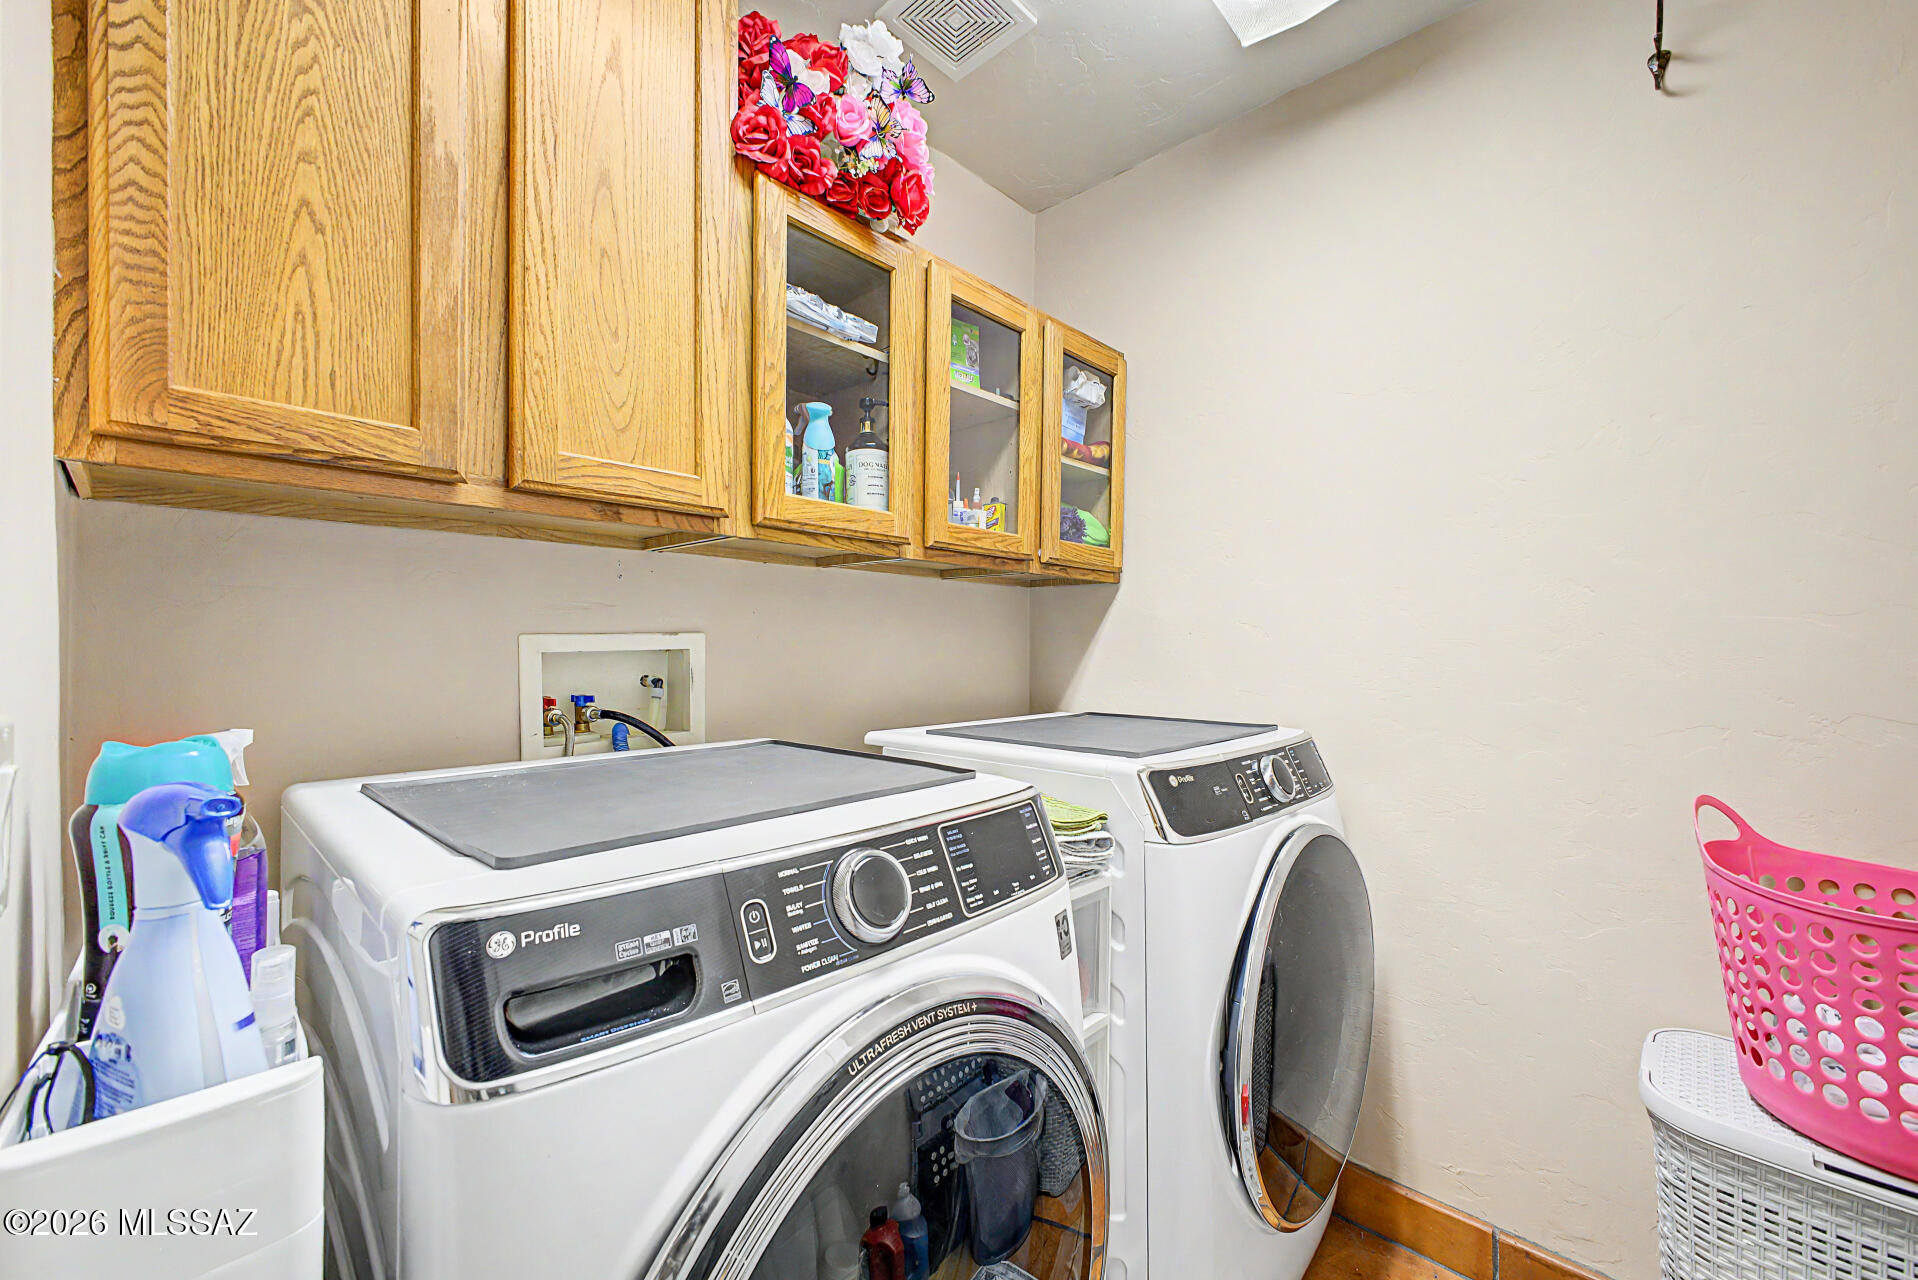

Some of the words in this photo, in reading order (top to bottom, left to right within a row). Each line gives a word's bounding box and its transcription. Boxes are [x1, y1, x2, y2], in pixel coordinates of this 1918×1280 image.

[520, 922, 582, 948] Profile
[801, 960, 821, 973] POWER
[821, 954, 839, 966] CLEAN
[848, 1024, 913, 1076] ULTRAFRESH
[911, 1011, 936, 1032] VENT
